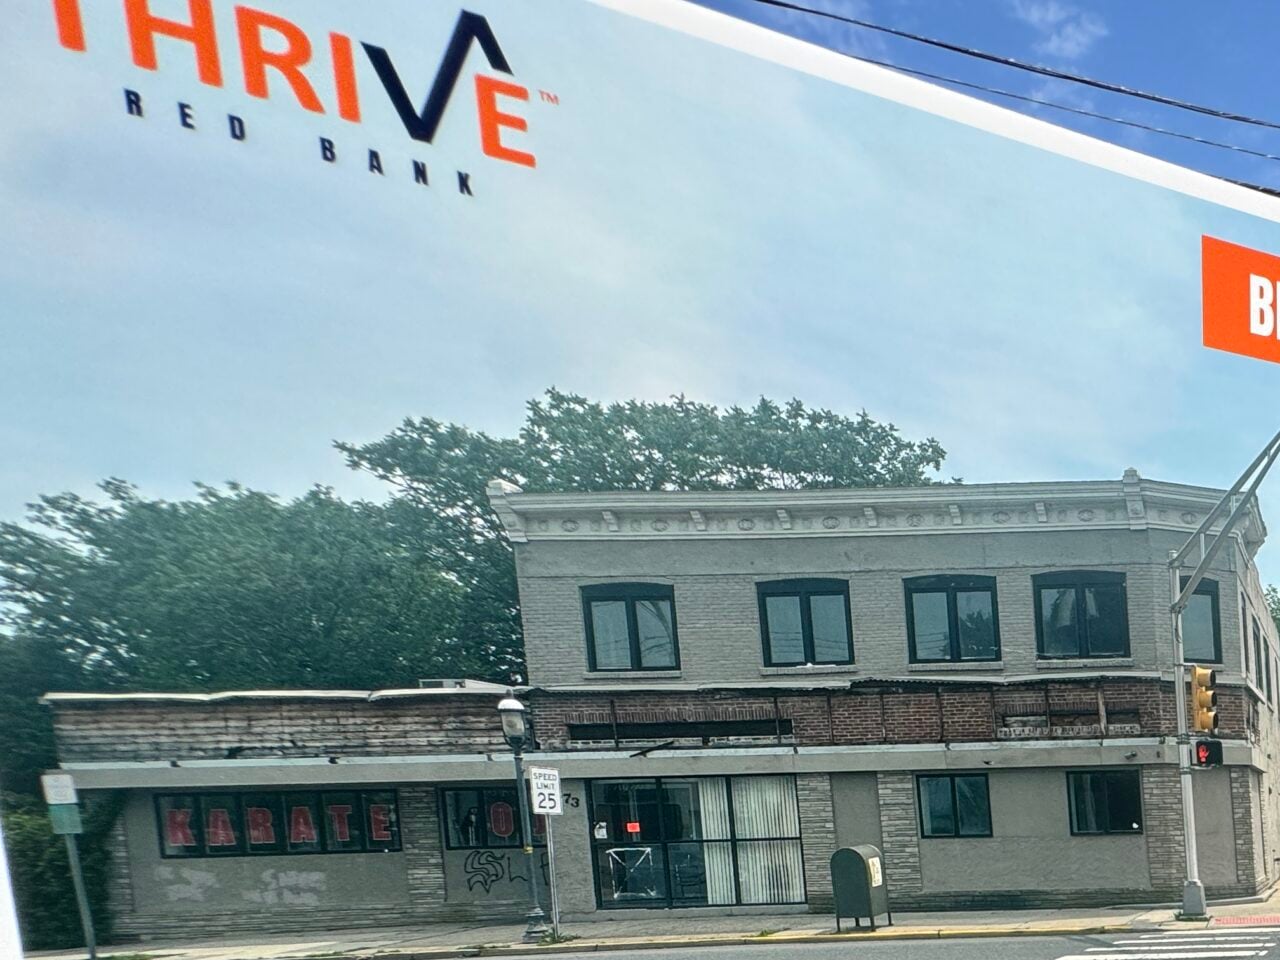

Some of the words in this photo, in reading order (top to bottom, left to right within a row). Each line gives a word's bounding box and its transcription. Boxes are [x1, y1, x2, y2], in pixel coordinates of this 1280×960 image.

[122, 87, 248, 141] RED
[319, 136, 474, 197] BANK
[532, 772, 557, 781] SPEED
[536, 782, 555, 790] LIMIT
[537, 792, 557, 809] 25
[166, 804, 392, 846] KARATE
